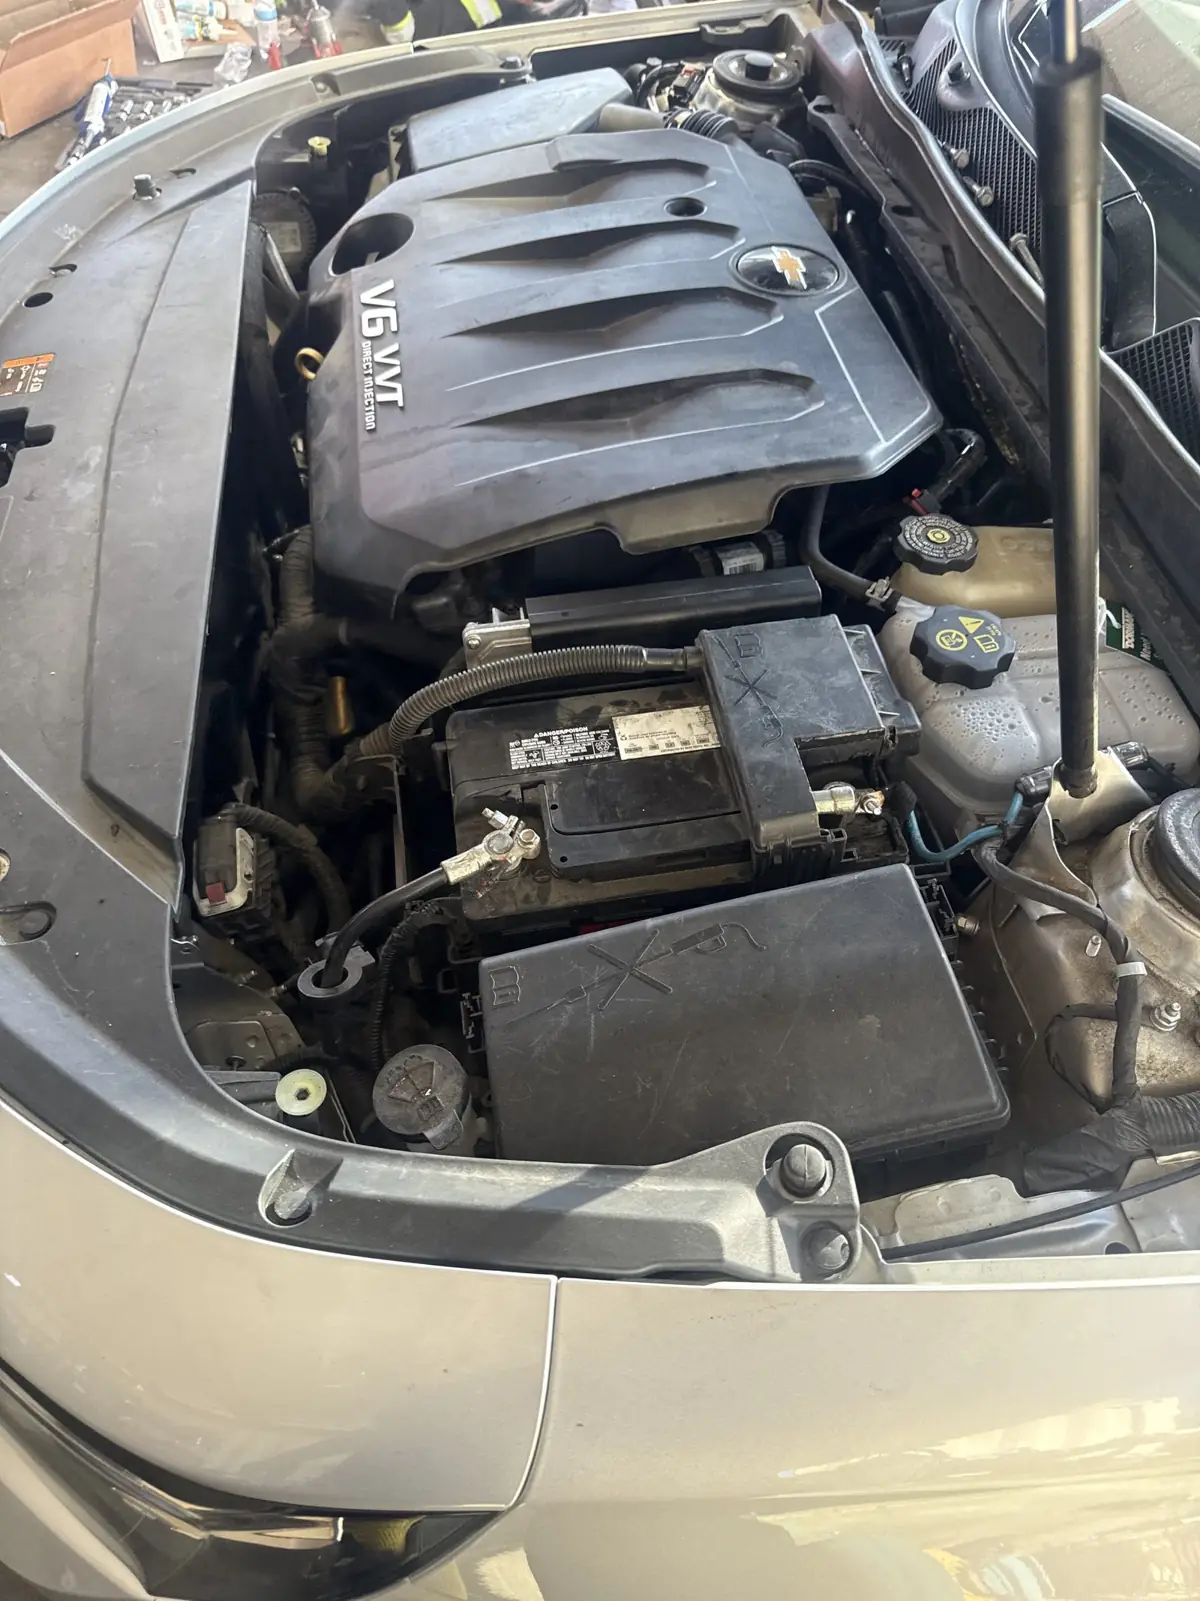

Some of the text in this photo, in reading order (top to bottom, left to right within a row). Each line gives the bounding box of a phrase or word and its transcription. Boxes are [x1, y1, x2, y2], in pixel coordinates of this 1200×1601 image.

[360, 278, 404, 408] V6 VVT
[361, 340, 376, 430] DIRECT INJECTION
